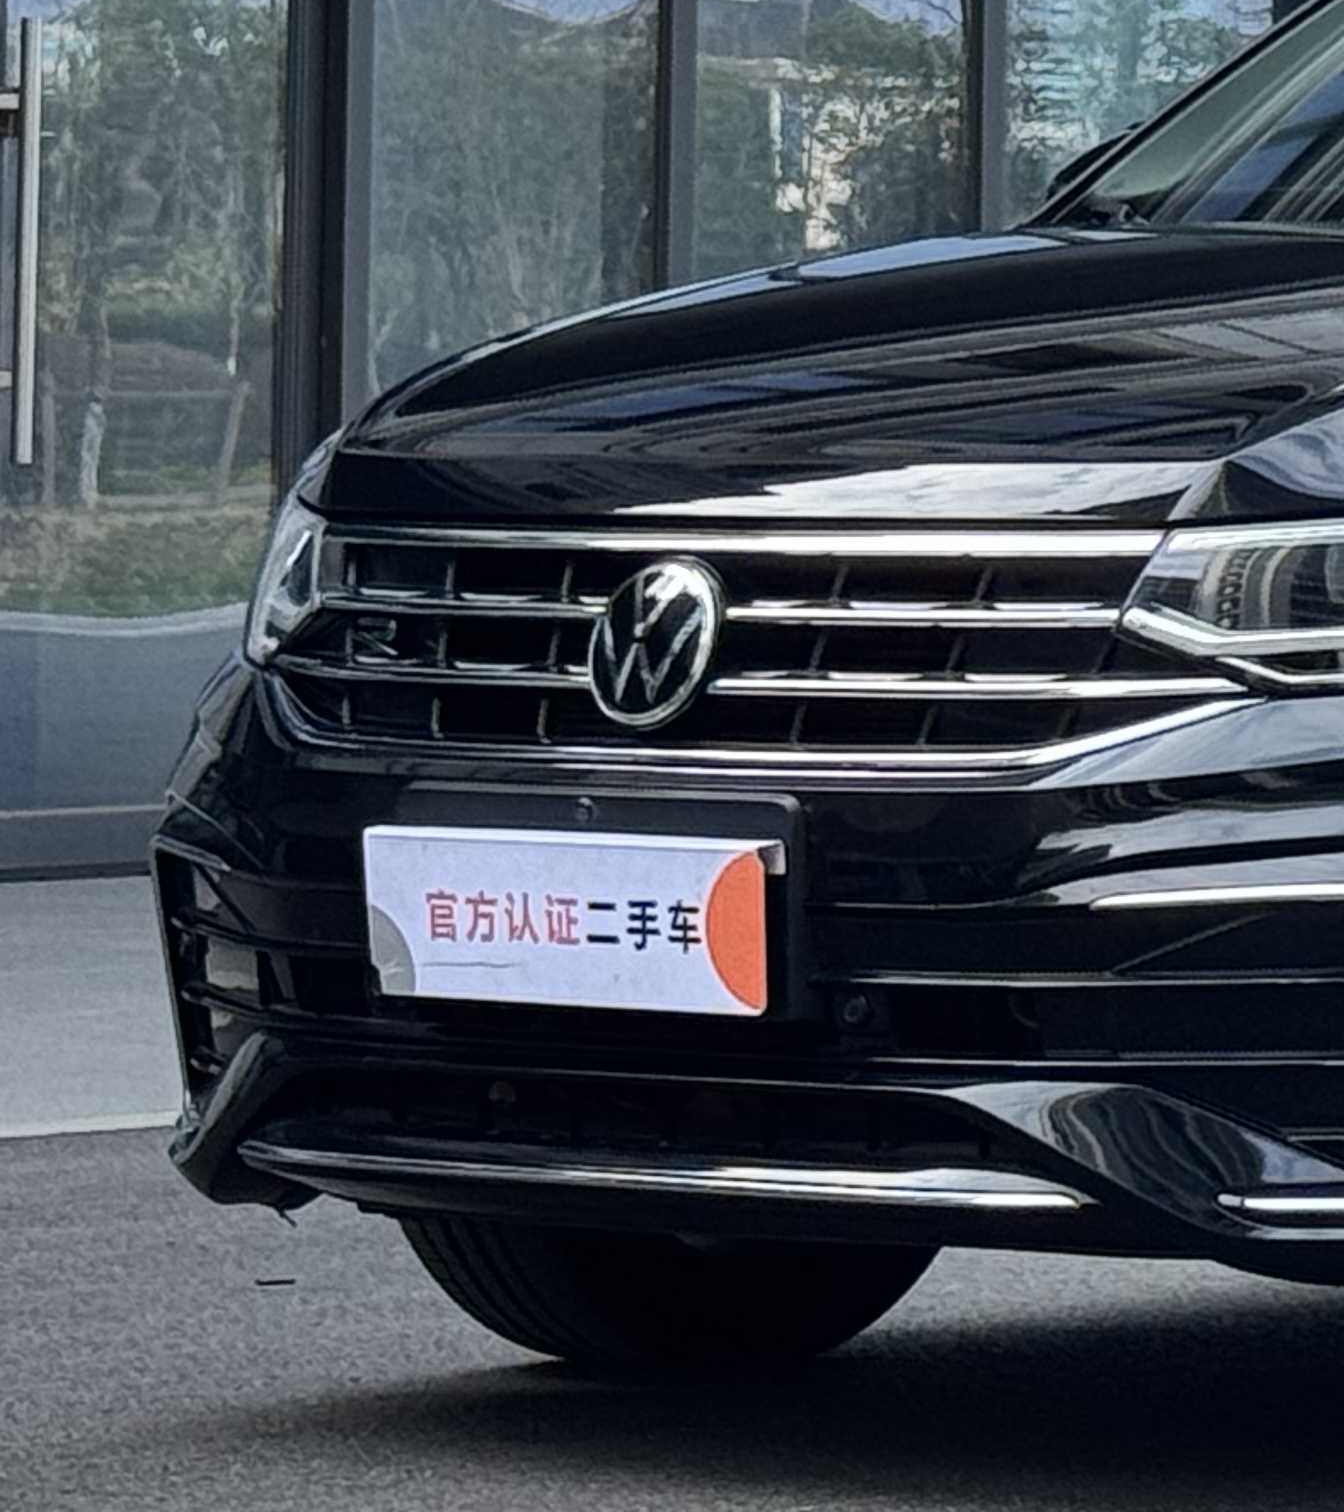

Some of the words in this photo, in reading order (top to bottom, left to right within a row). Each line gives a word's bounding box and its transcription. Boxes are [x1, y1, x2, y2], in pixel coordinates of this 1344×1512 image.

[590, 557, 720, 729] VW
[425, 889, 702, 953] 官方认证二手车
